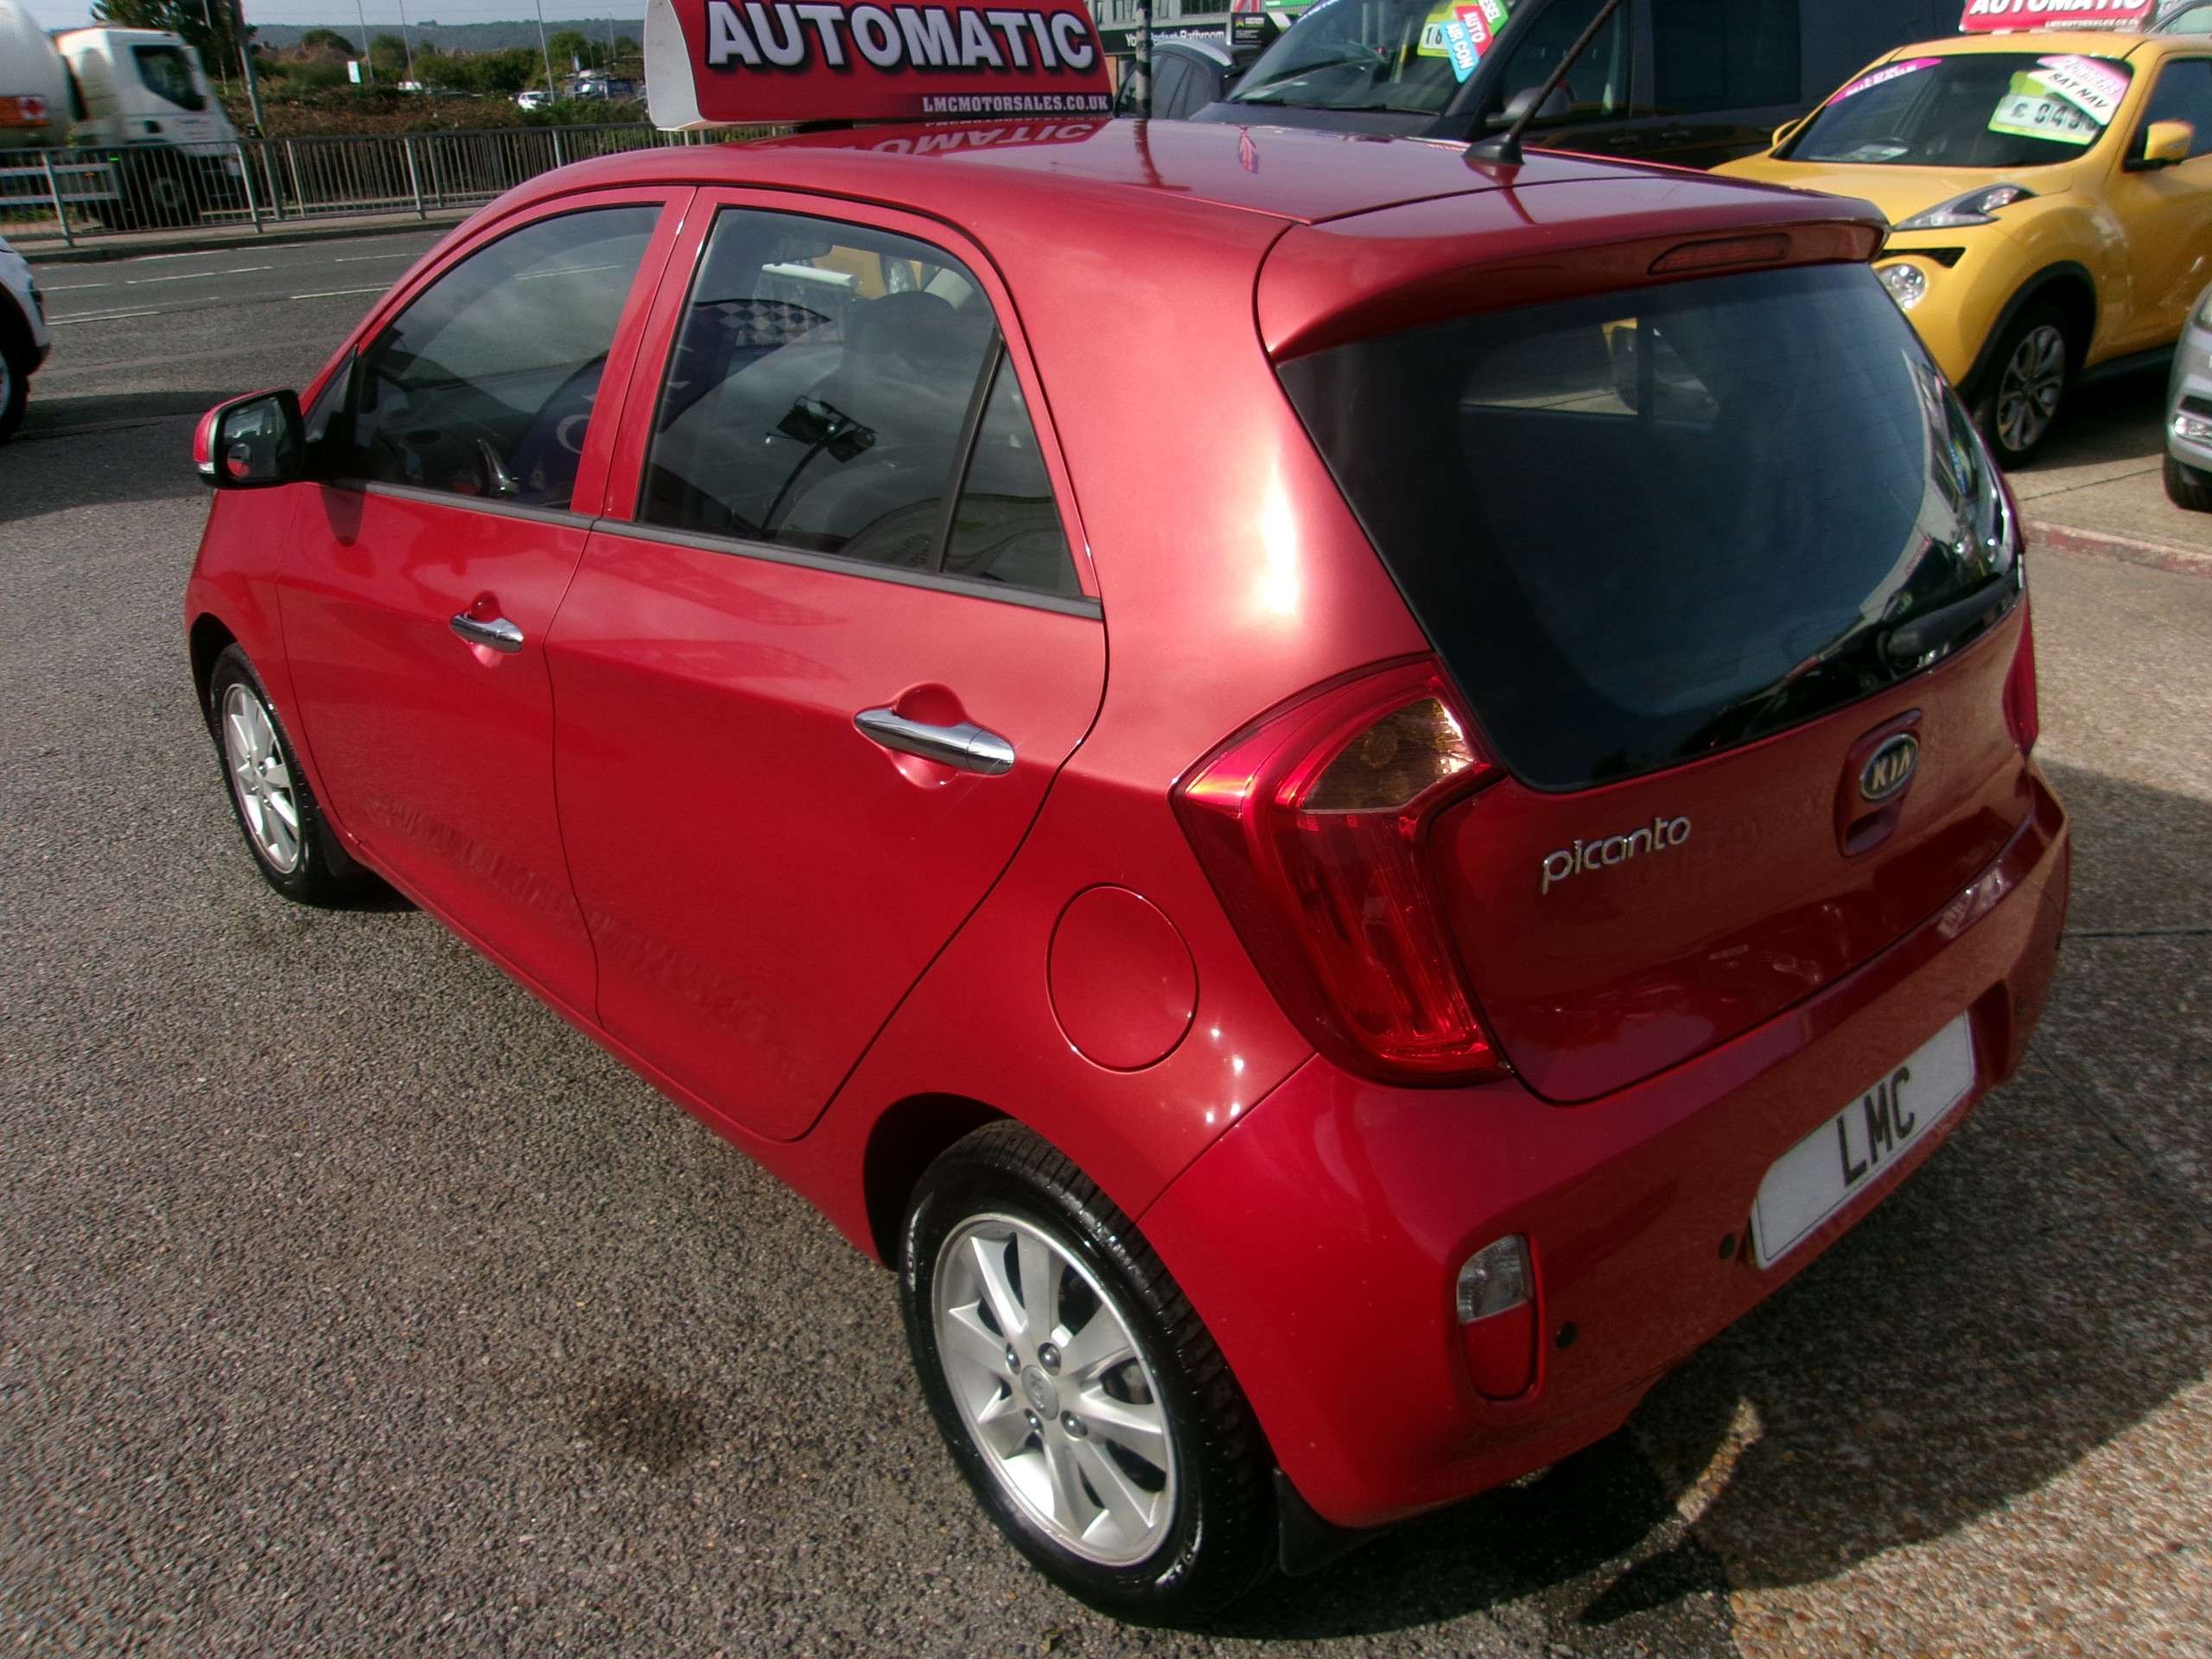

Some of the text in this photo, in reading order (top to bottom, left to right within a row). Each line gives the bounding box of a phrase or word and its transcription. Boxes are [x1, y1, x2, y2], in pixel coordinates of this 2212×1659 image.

[709, 1, 1093, 69] AUTOMATIC
[1446, 22, 1475, 70] AIR CON
[1463, 11, 1486, 43] AUTO
[923, 96, 1109, 112] LMCMOTORSALES.CO.UK
[2048, 73, 2109, 108] SAT NAV
[1872, 745, 1910, 790] KIA
[1541, 815, 1692, 894] picanto
[1835, 1066, 1916, 1188] LMC
